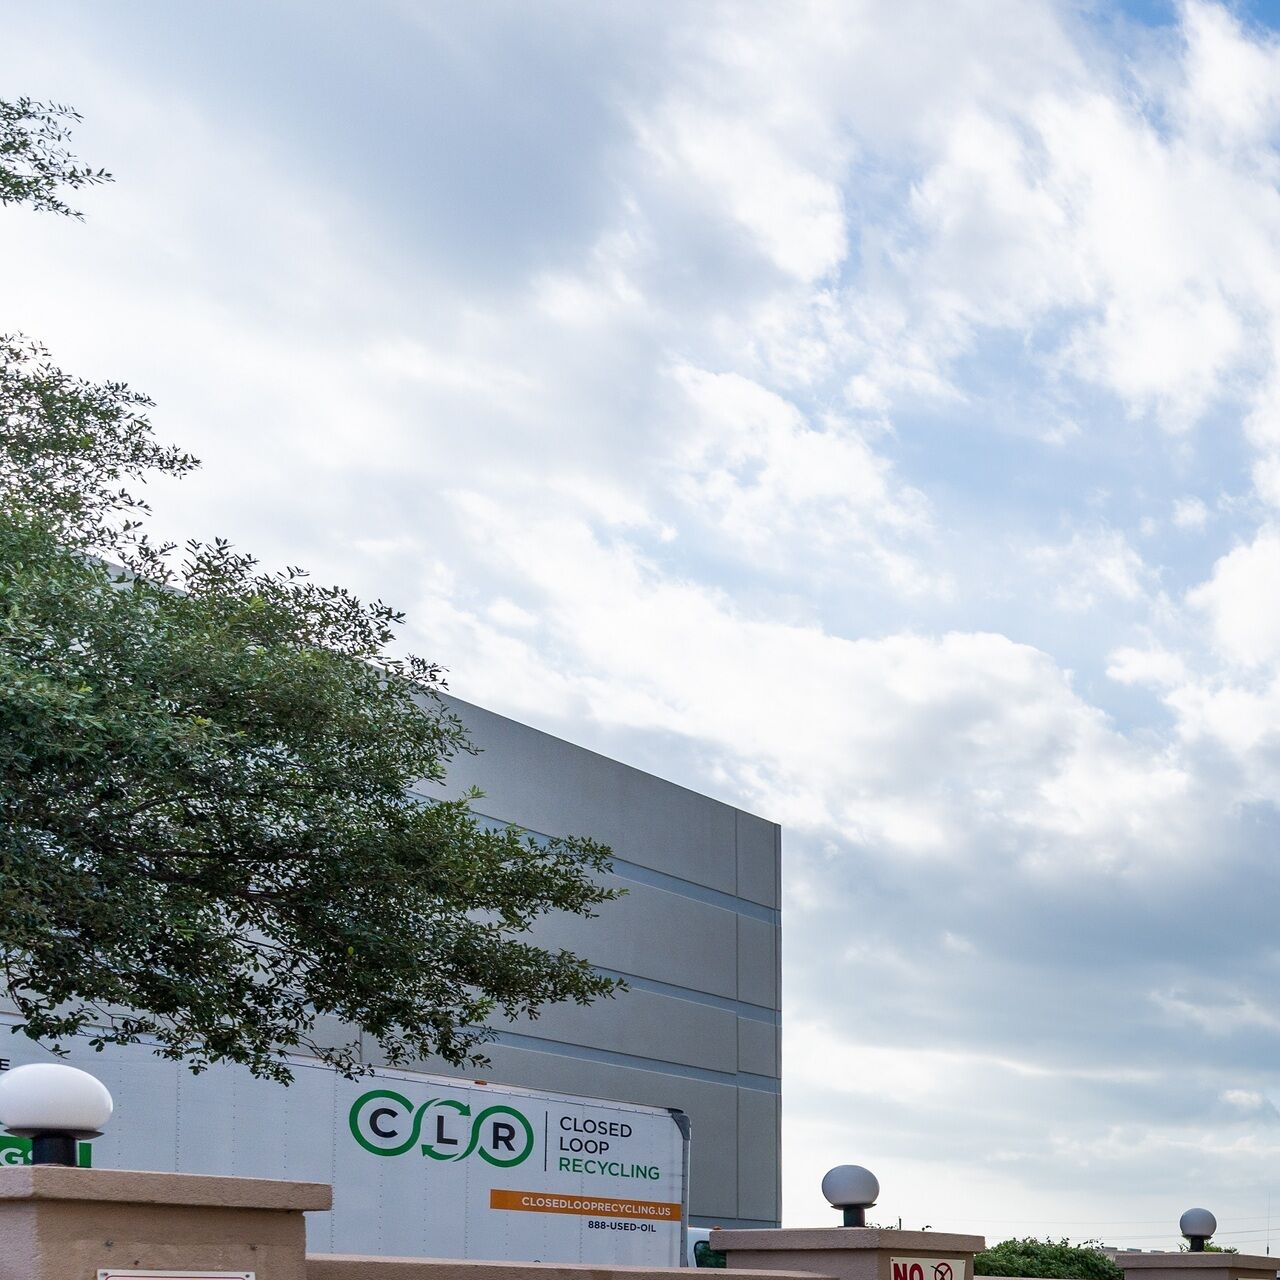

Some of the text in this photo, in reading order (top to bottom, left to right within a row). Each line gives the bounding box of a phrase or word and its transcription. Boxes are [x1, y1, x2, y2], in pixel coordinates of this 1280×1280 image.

[559, 1116, 632, 1138] CLOSED
[559, 1136, 610, 1155] LOOP
[559, 1157, 660, 1180] RECYCLING
[521, 1196, 671, 1216] CLOSEDLOOPRECYCLING.US
[588, 1220, 656, 1232] 888-USED-OIL
